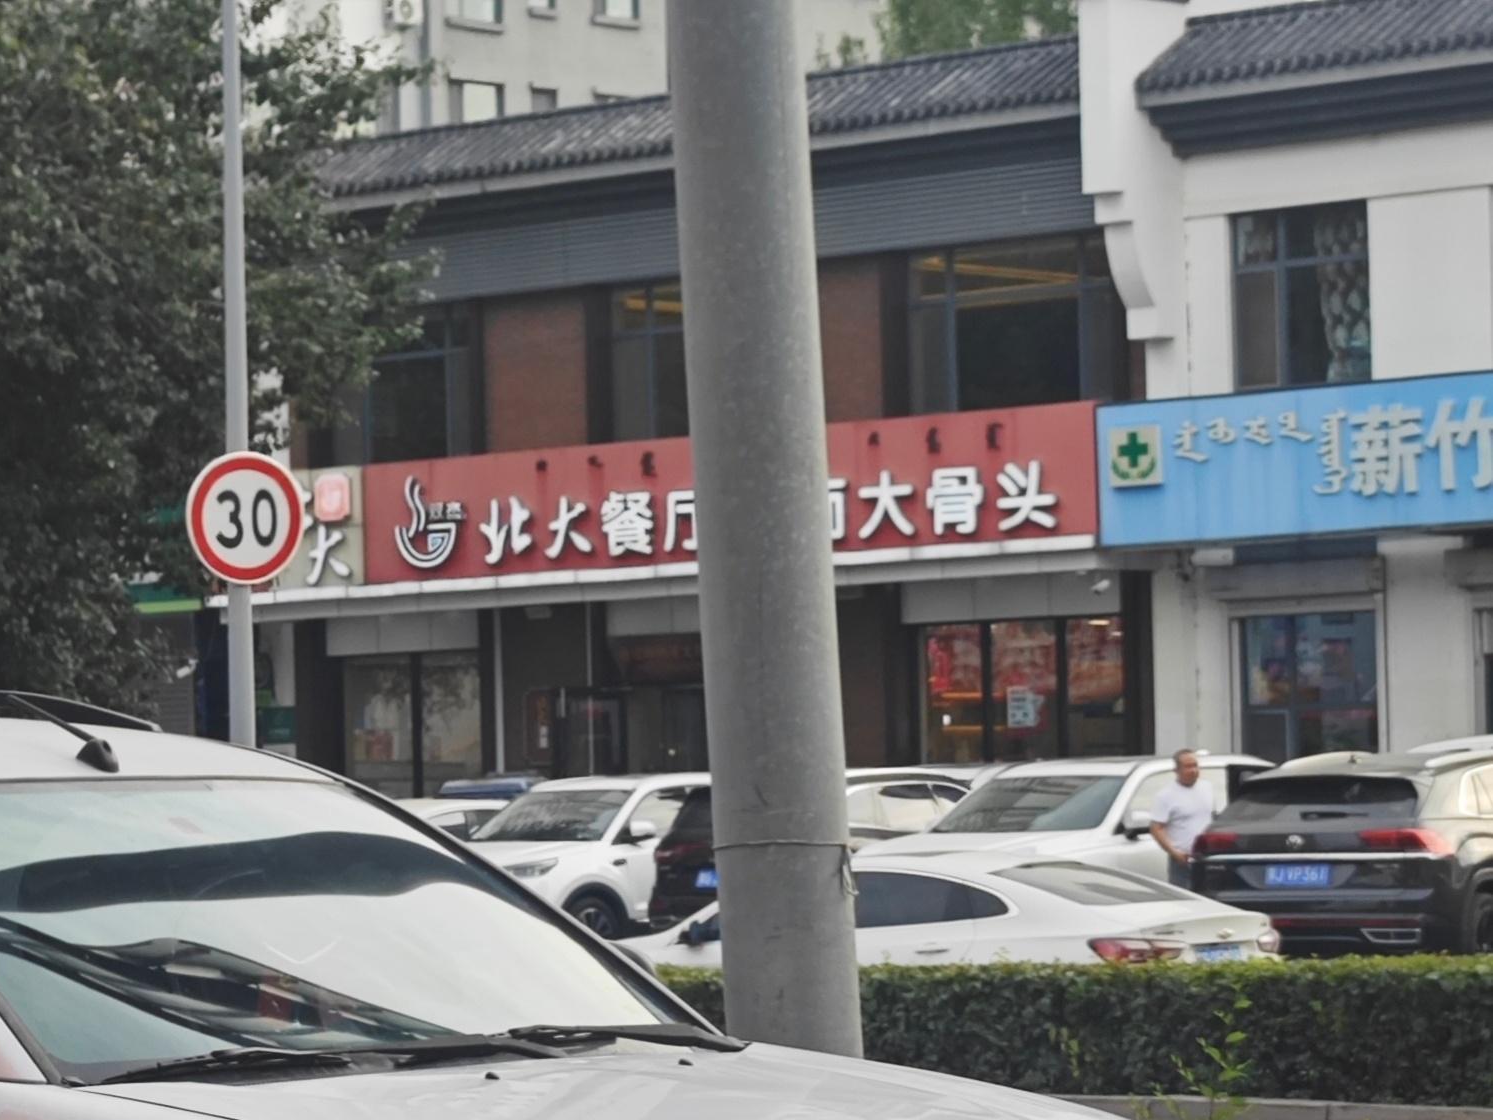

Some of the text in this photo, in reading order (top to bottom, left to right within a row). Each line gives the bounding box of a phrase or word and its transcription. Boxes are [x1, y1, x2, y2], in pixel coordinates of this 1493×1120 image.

[216, 488, 277, 550] 30
[479, 488, 698, 566] 北大餐厅
